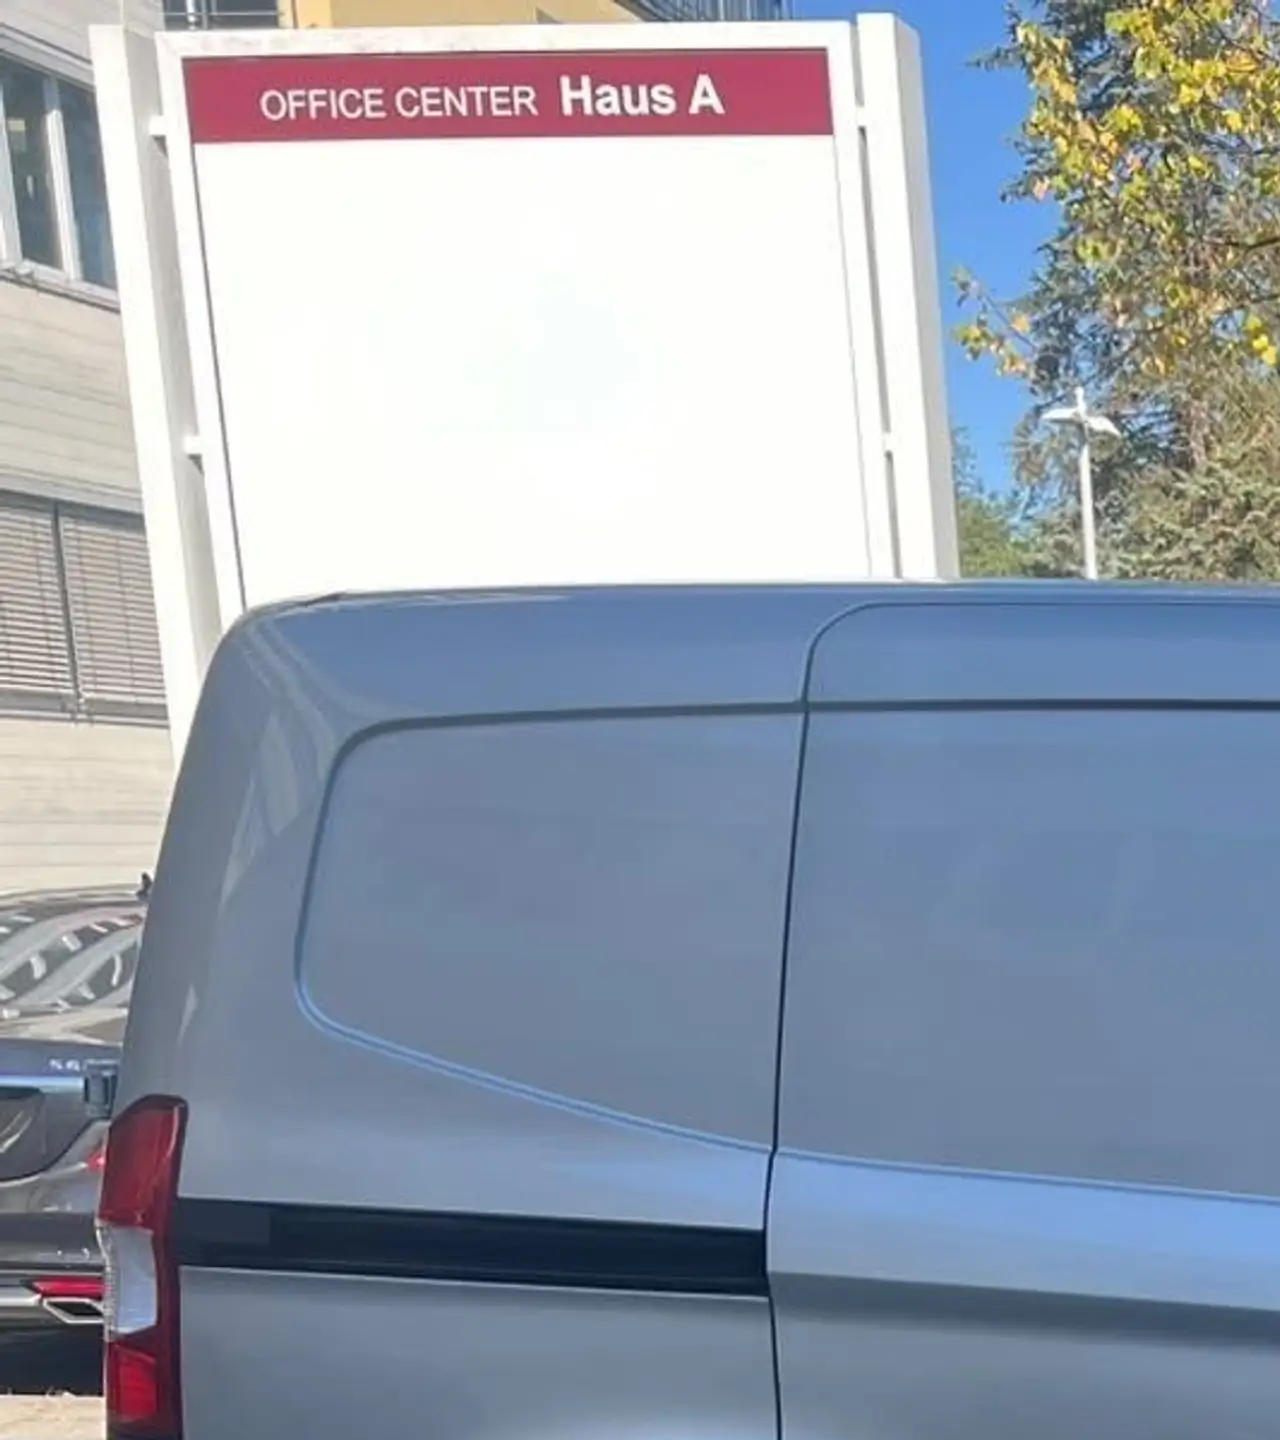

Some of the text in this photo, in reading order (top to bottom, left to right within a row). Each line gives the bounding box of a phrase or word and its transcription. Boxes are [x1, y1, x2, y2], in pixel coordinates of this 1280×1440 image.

[259, 74, 725, 121] OFFICE CENTER Haus A
